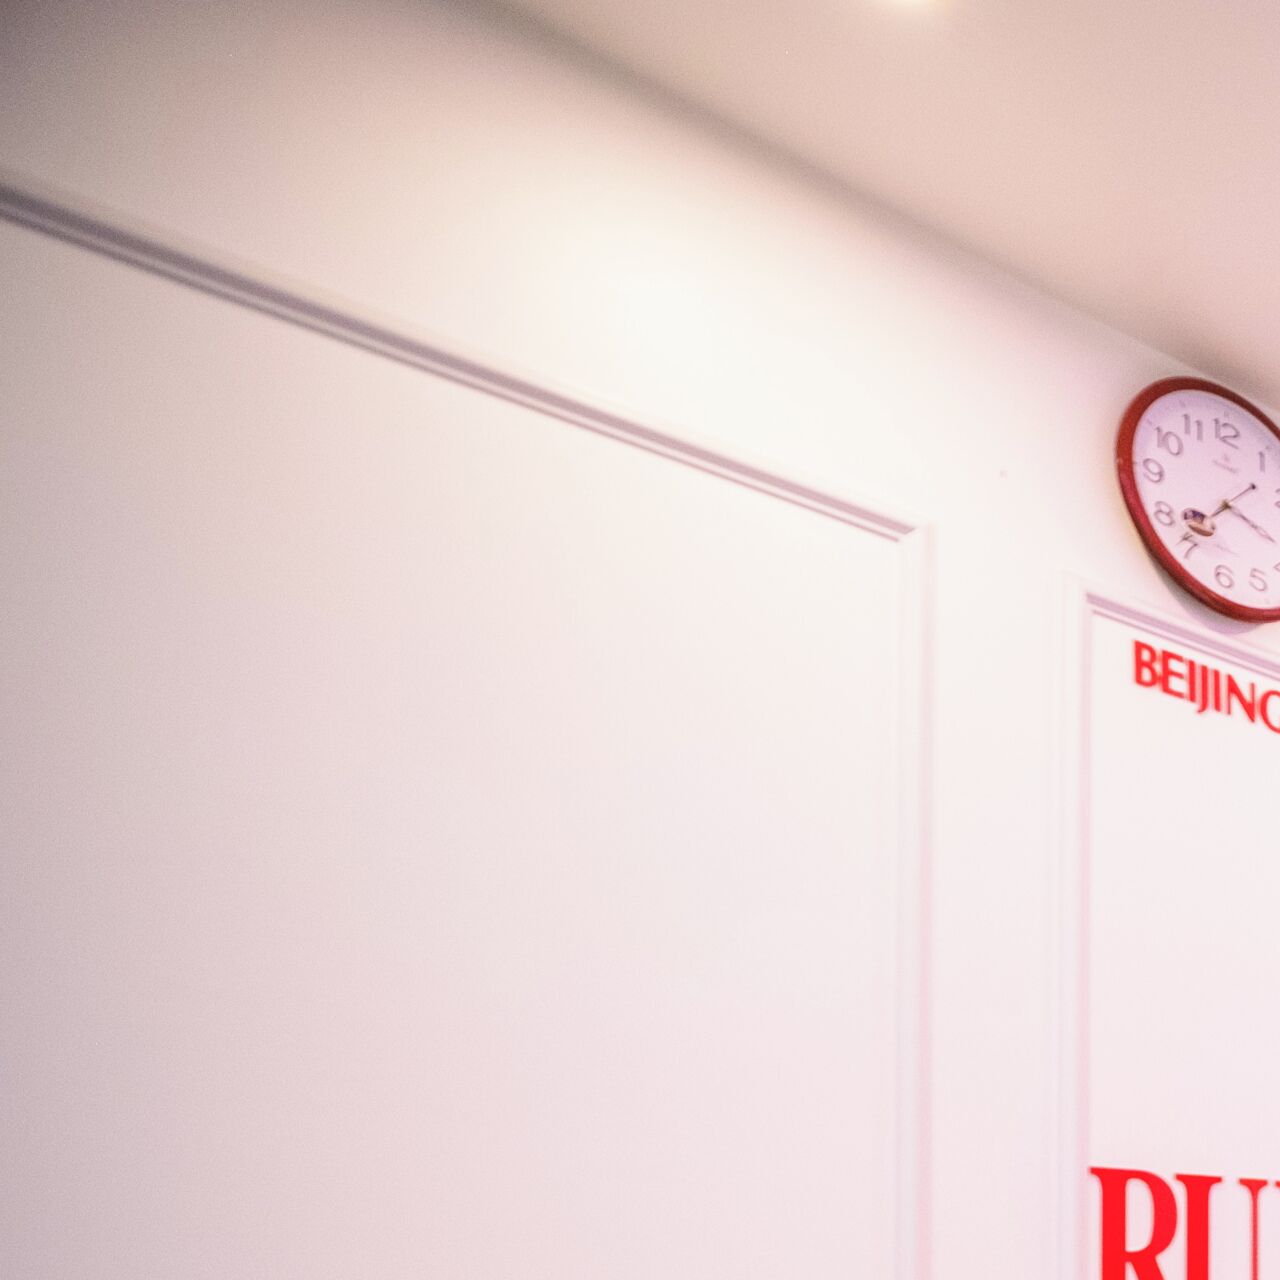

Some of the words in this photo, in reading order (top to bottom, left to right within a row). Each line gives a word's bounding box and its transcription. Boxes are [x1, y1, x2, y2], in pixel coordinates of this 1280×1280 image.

[1183, 413, 1203, 442] 11
[1214, 418, 1240, 449] 12
[1154, 426, 1183, 456] 10
[1143, 458, 1165, 483] 9
[1258, 451, 1266, 472] 1
[1154, 501, 1176, 527] 8
[1214, 564, 1234, 589] 6
[1249, 568, 1268, 592] 5
